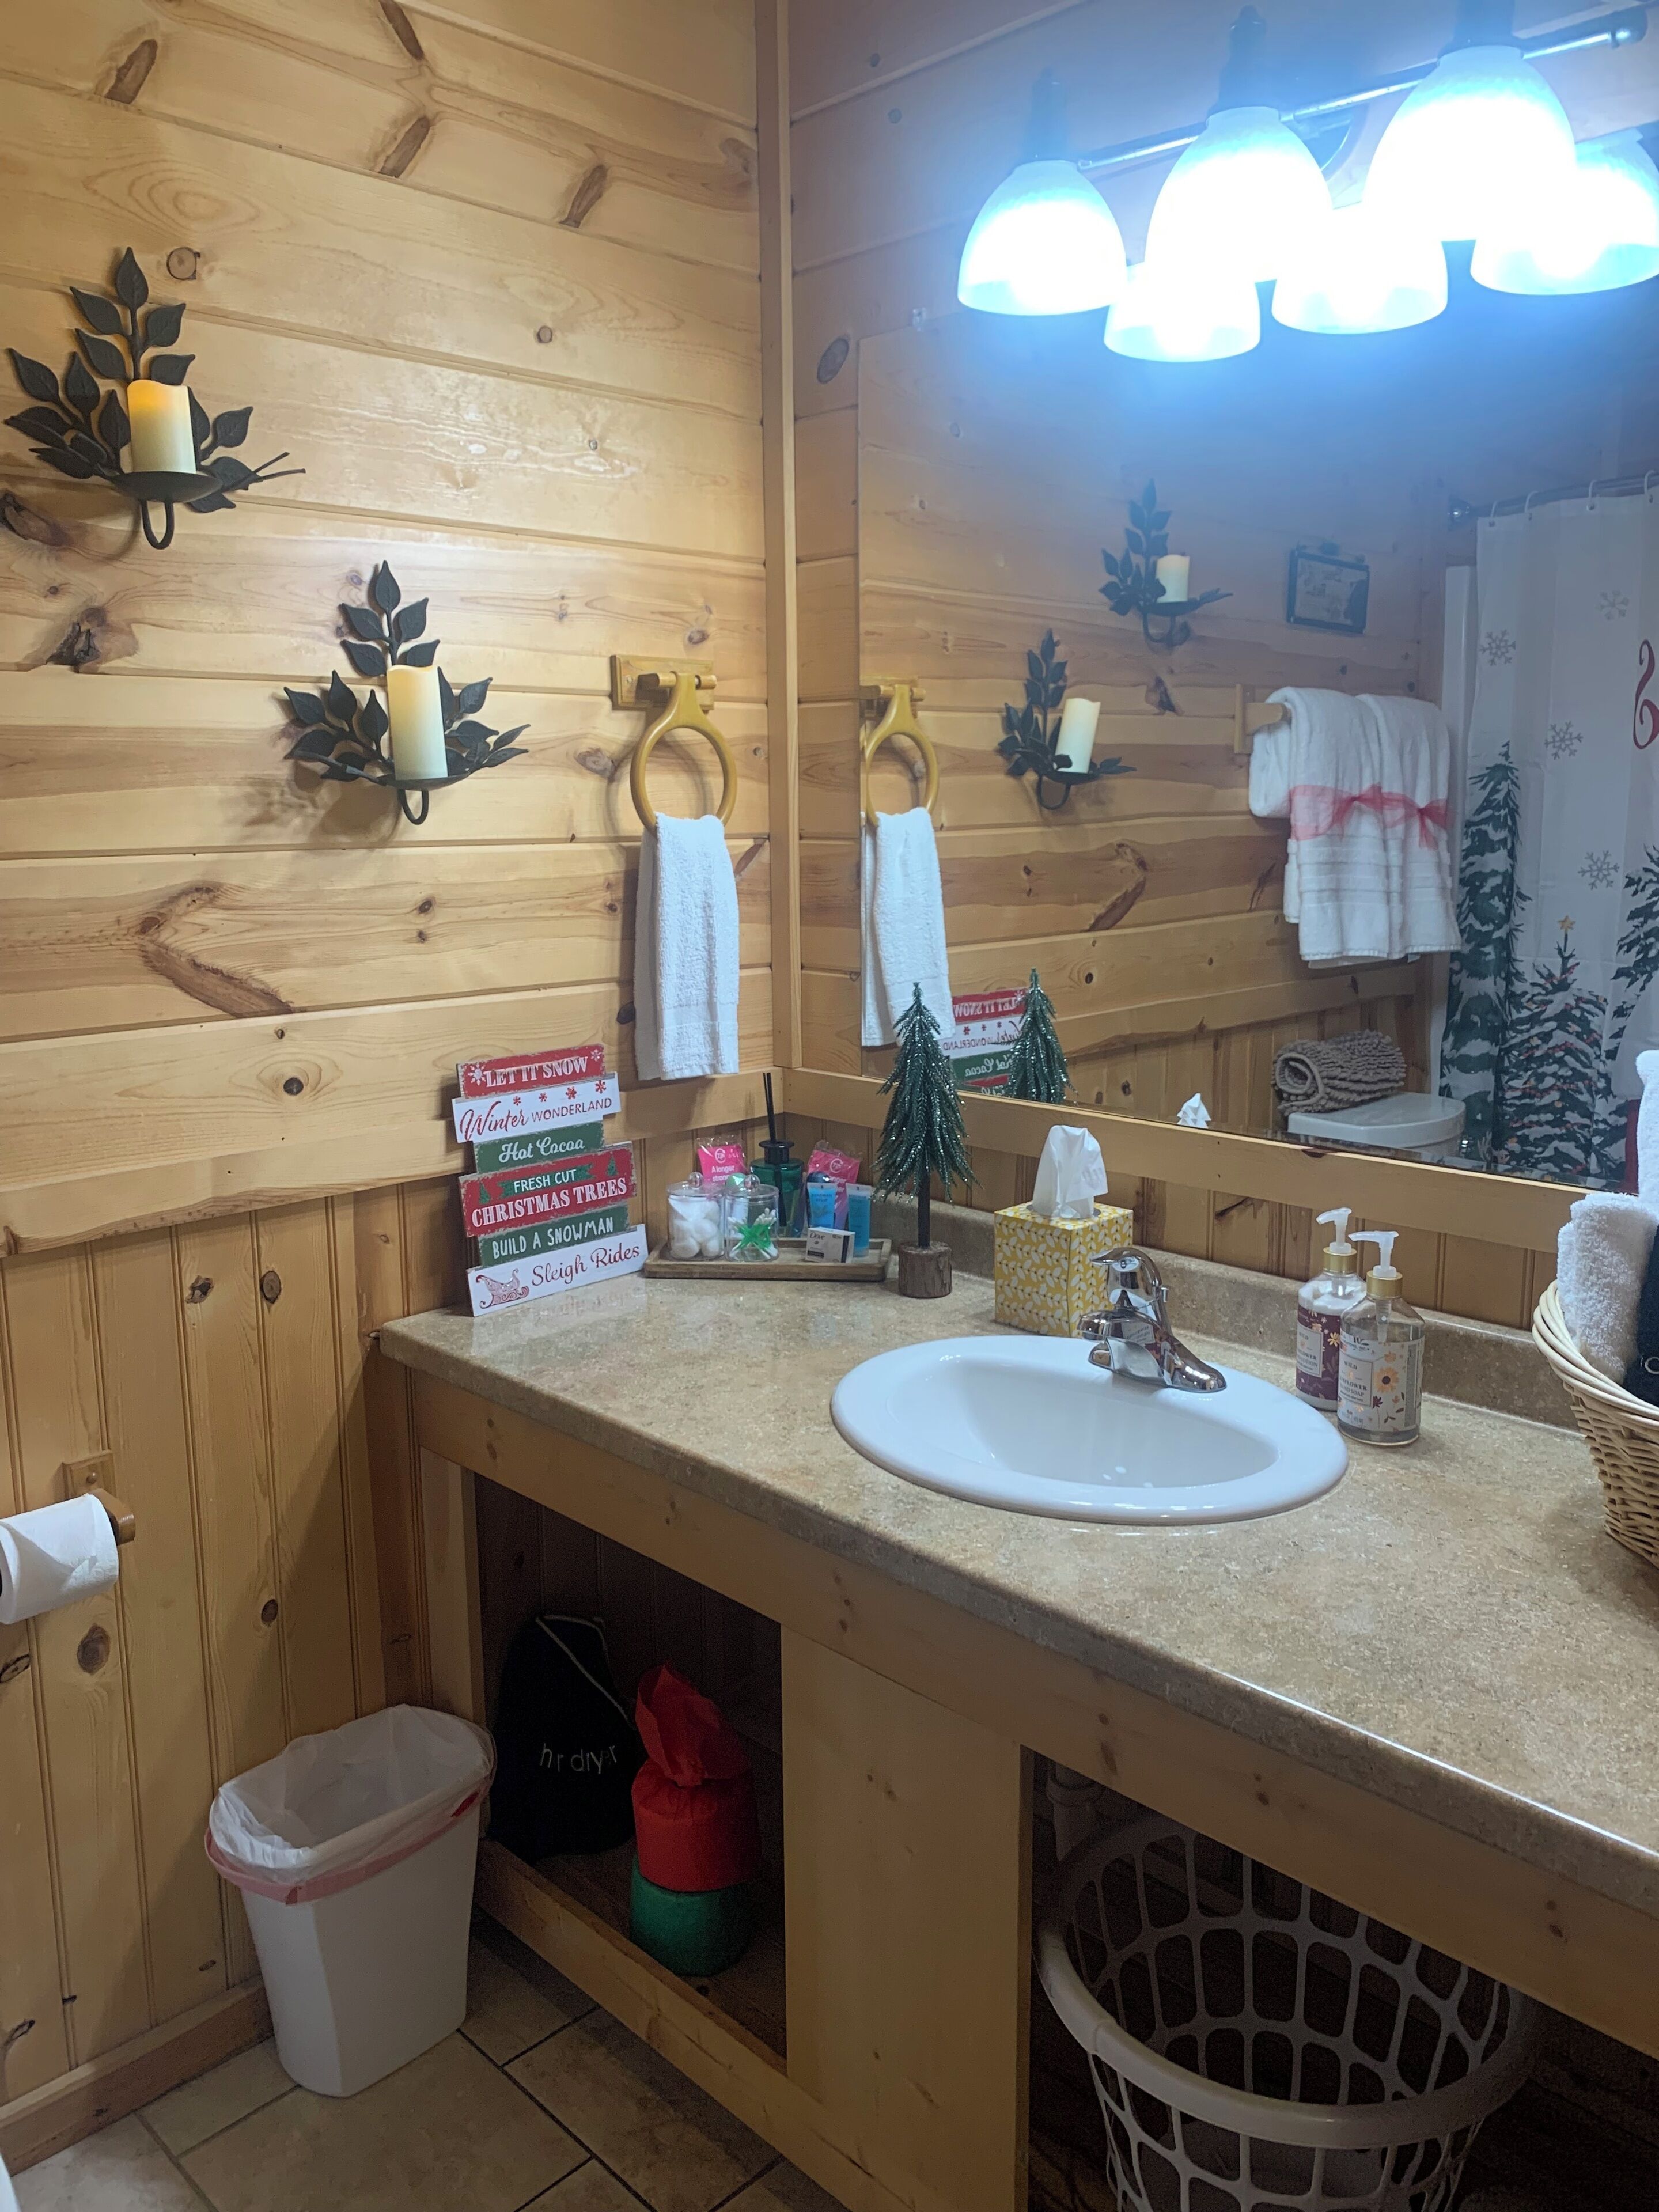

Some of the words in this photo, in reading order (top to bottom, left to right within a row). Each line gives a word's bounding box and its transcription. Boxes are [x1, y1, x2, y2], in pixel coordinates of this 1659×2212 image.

[483, 1067, 517, 1088] LET
[517, 1063, 539, 1082] IT
[542, 1056, 588, 1079] SNOW
[459, 1100, 529, 1142] Winter
[531, 1097, 612, 1123] WONDERLAND
[498, 1142, 534, 1163] Hot
[536, 1137, 585, 1157] Cocoa
[514, 1175, 551, 1194] FRESH
[555, 1169, 577, 1183] CUT
[717, 1165, 734, 1173] longer
[471, 1189, 570, 1228] CHRISTMAS
[573, 1177, 627, 1205] TREES
[492, 1235, 527, 1260] BUILD
[533, 1232, 542, 1249] A
[547, 1217, 614, 1246] SNOWMAN
[809, 1232, 825, 1240] Dove
[532, 1254, 588, 1287] Sleigh
[590, 1243, 640, 1268] Rides
[1344, 1361, 1358, 1370] WILD
